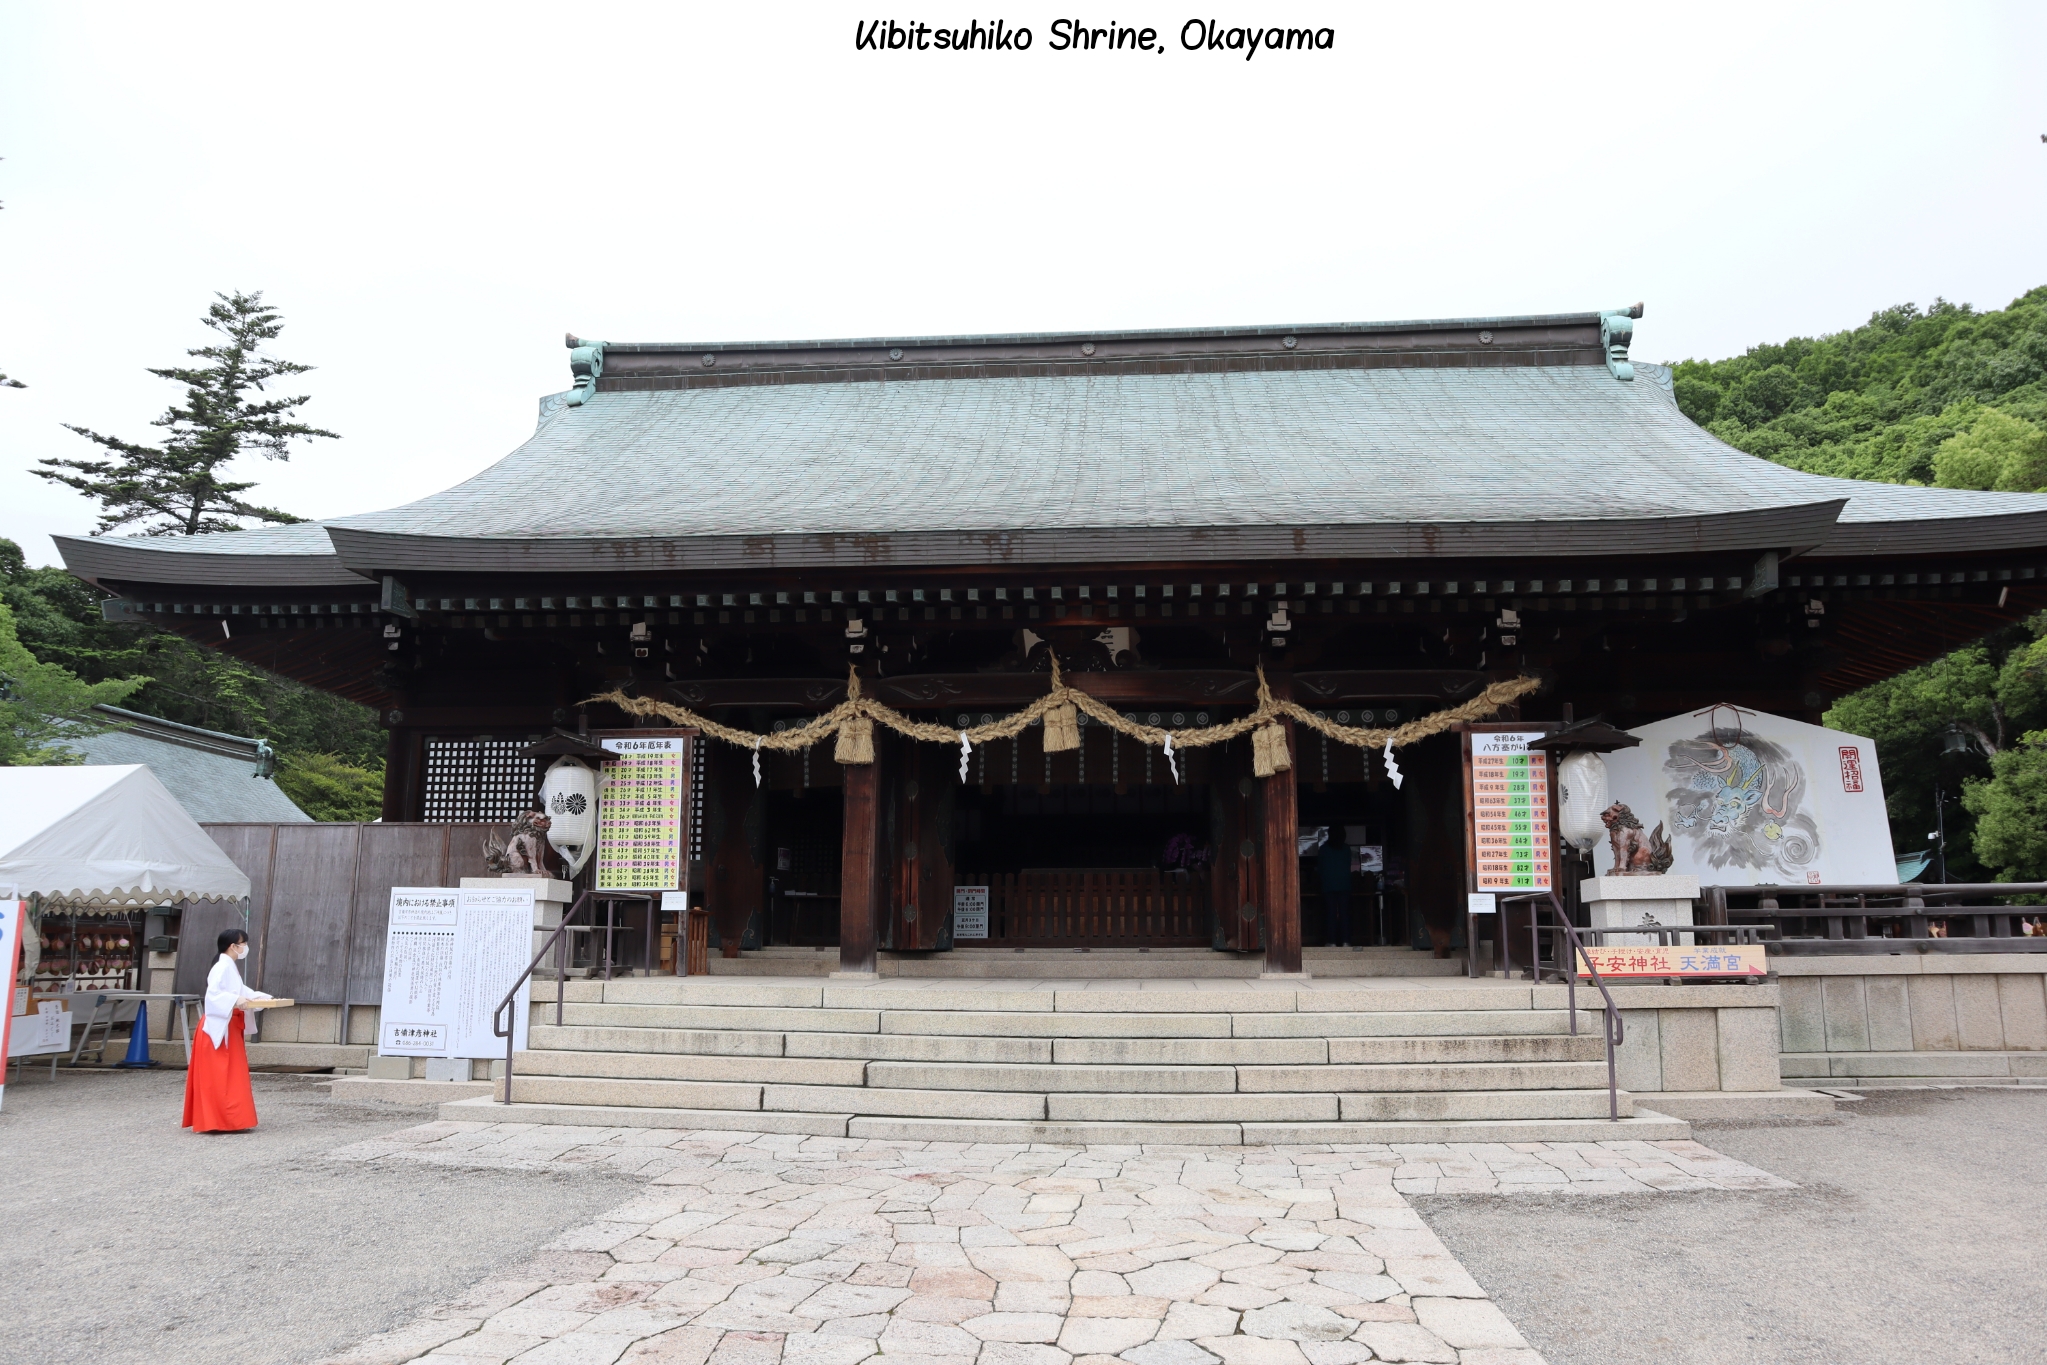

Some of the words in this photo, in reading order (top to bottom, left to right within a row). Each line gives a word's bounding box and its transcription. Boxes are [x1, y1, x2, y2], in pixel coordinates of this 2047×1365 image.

[615, 741, 672, 750] 令和6年厄年表
[1841, 749, 1861, 791] 開運招福
[395, 897, 455, 908] 境内における禁止事項
[1584, 955, 1671, 972] 子安神社
[1680, 955, 1741, 971] 天満宮
[393, 1028, 438, 1038] 吉備津彦神社
